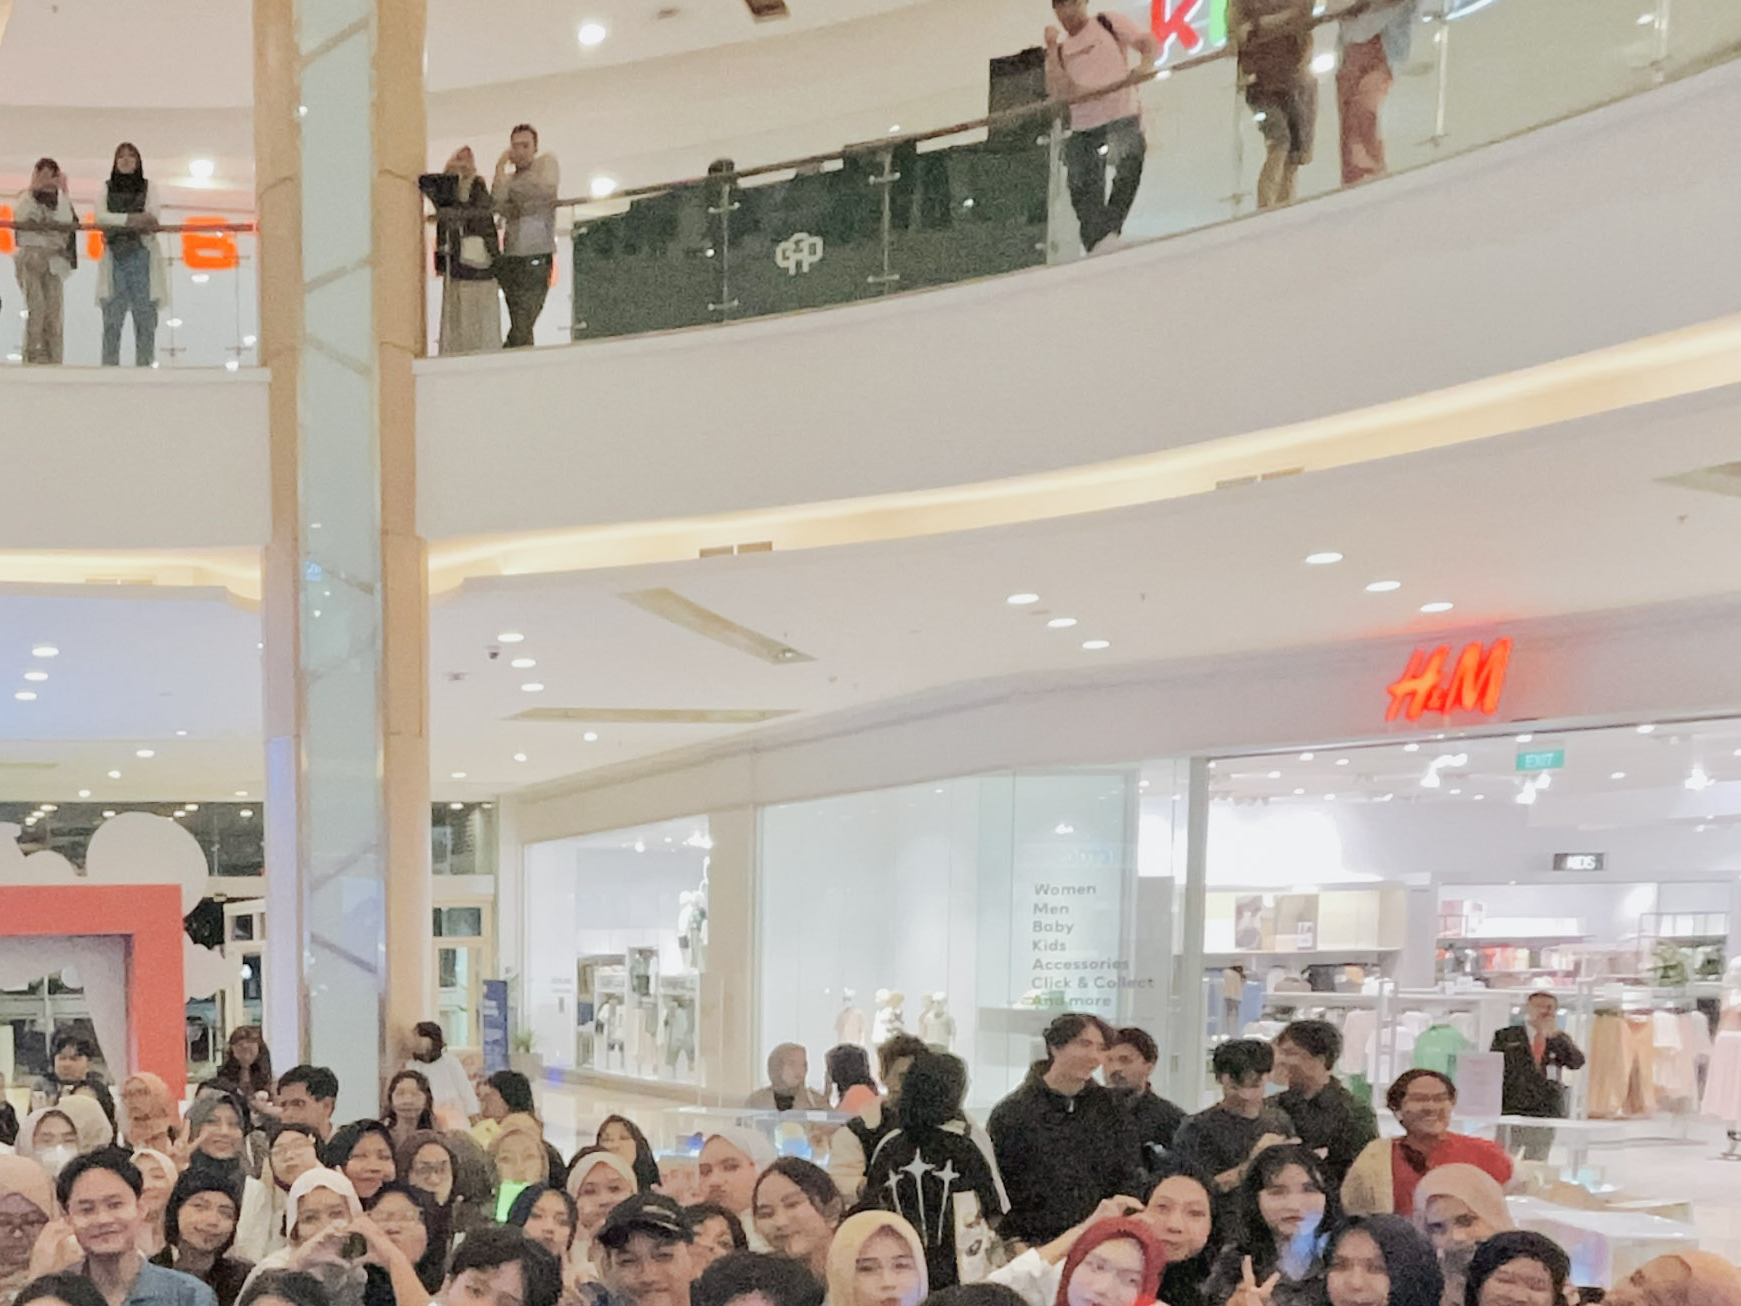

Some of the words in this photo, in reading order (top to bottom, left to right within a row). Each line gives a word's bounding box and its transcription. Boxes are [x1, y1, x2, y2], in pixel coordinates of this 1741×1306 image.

[1385, 637, 1513, 722] H&M
[1524, 752, 1555, 768] EXIT
[1034, 884, 1096, 896] Women
[1033, 903, 1070, 915] Men
[1032, 920, 1075, 934] Baby
[1032, 939, 1066, 951] Kids
[1032, 958, 1130, 970] Accessories
[1032, 976, 1072, 989] Click
[1078, 976, 1088, 988] &
[1094, 976, 1154, 989] Collect
[1032, 995, 1065, 1006] And
[1069, 996, 1111, 1007] more
